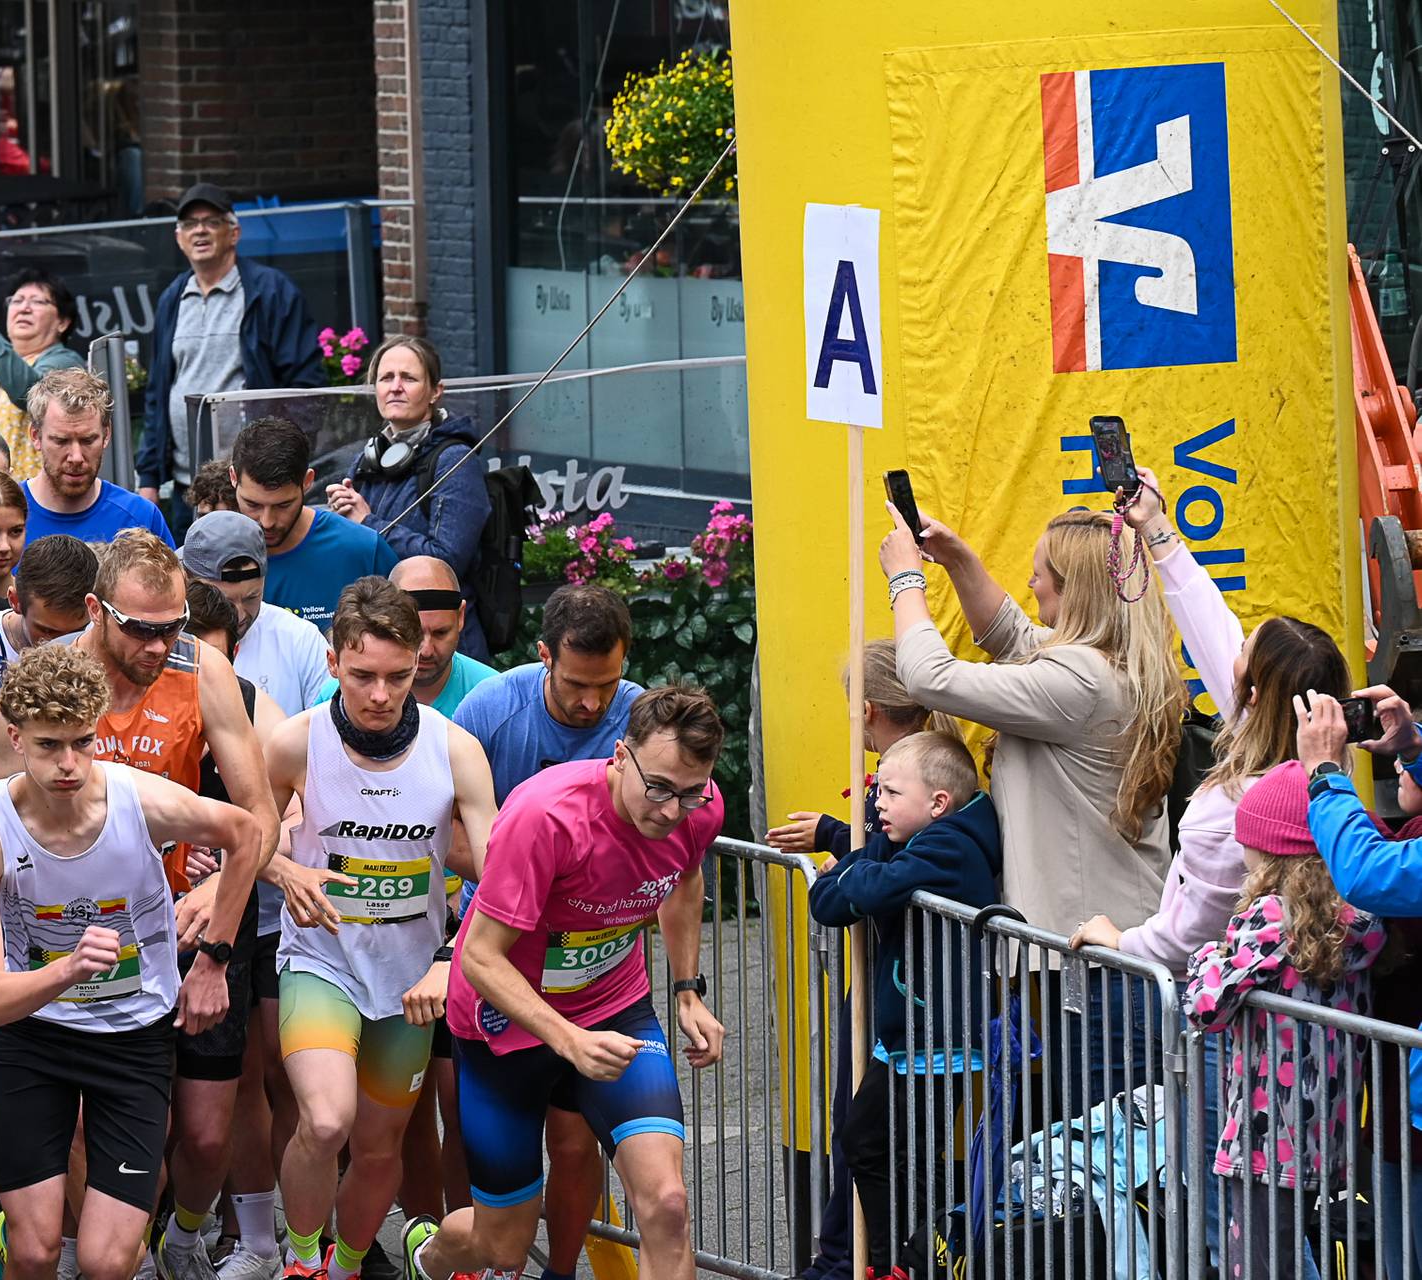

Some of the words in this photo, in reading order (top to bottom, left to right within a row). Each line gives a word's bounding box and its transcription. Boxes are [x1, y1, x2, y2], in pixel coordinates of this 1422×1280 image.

[814, 260, 878, 396] A
[302, 605, 326, 613] Yellow
[131, 735, 165, 757] FOX
[360, 788, 393, 797] CRAFT
[338, 820, 437, 841] RapiDOs
[595, 902, 618, 915] bad
[561, 932, 631, 968] 3003
[74, 983, 100, 991] Janus
